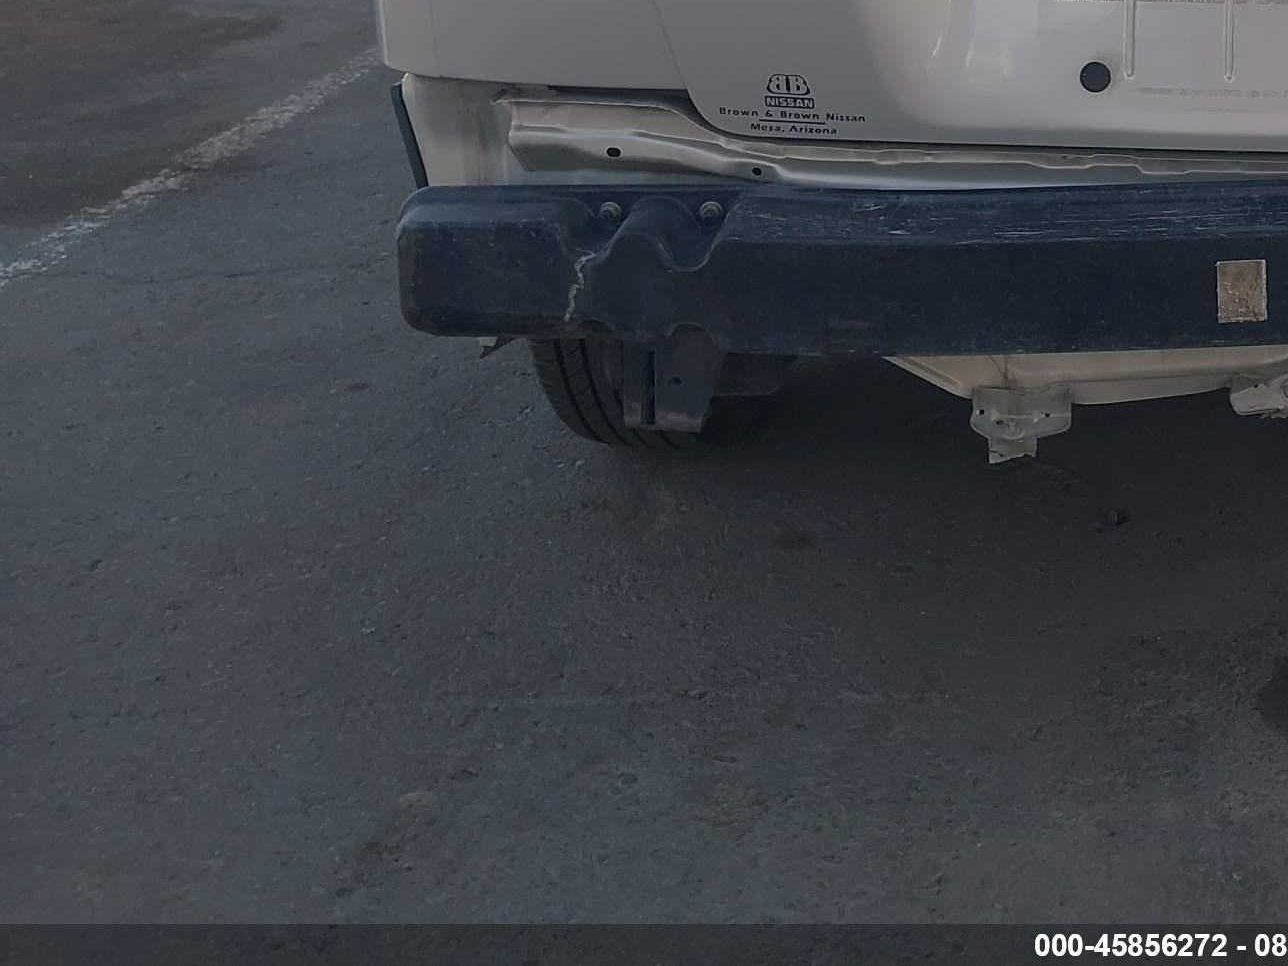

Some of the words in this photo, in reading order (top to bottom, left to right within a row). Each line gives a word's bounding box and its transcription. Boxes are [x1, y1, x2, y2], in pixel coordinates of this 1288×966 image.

[766, 97, 813, 108] NISSAN
[719, 107, 758, 117] Brown
[765, 110, 773, 118] &
[780, 110, 819, 120] Brown
[826, 113, 866, 122] Nissan
[751, 123, 785, 132] Mesa,
[789, 125, 837, 134] Arizona
